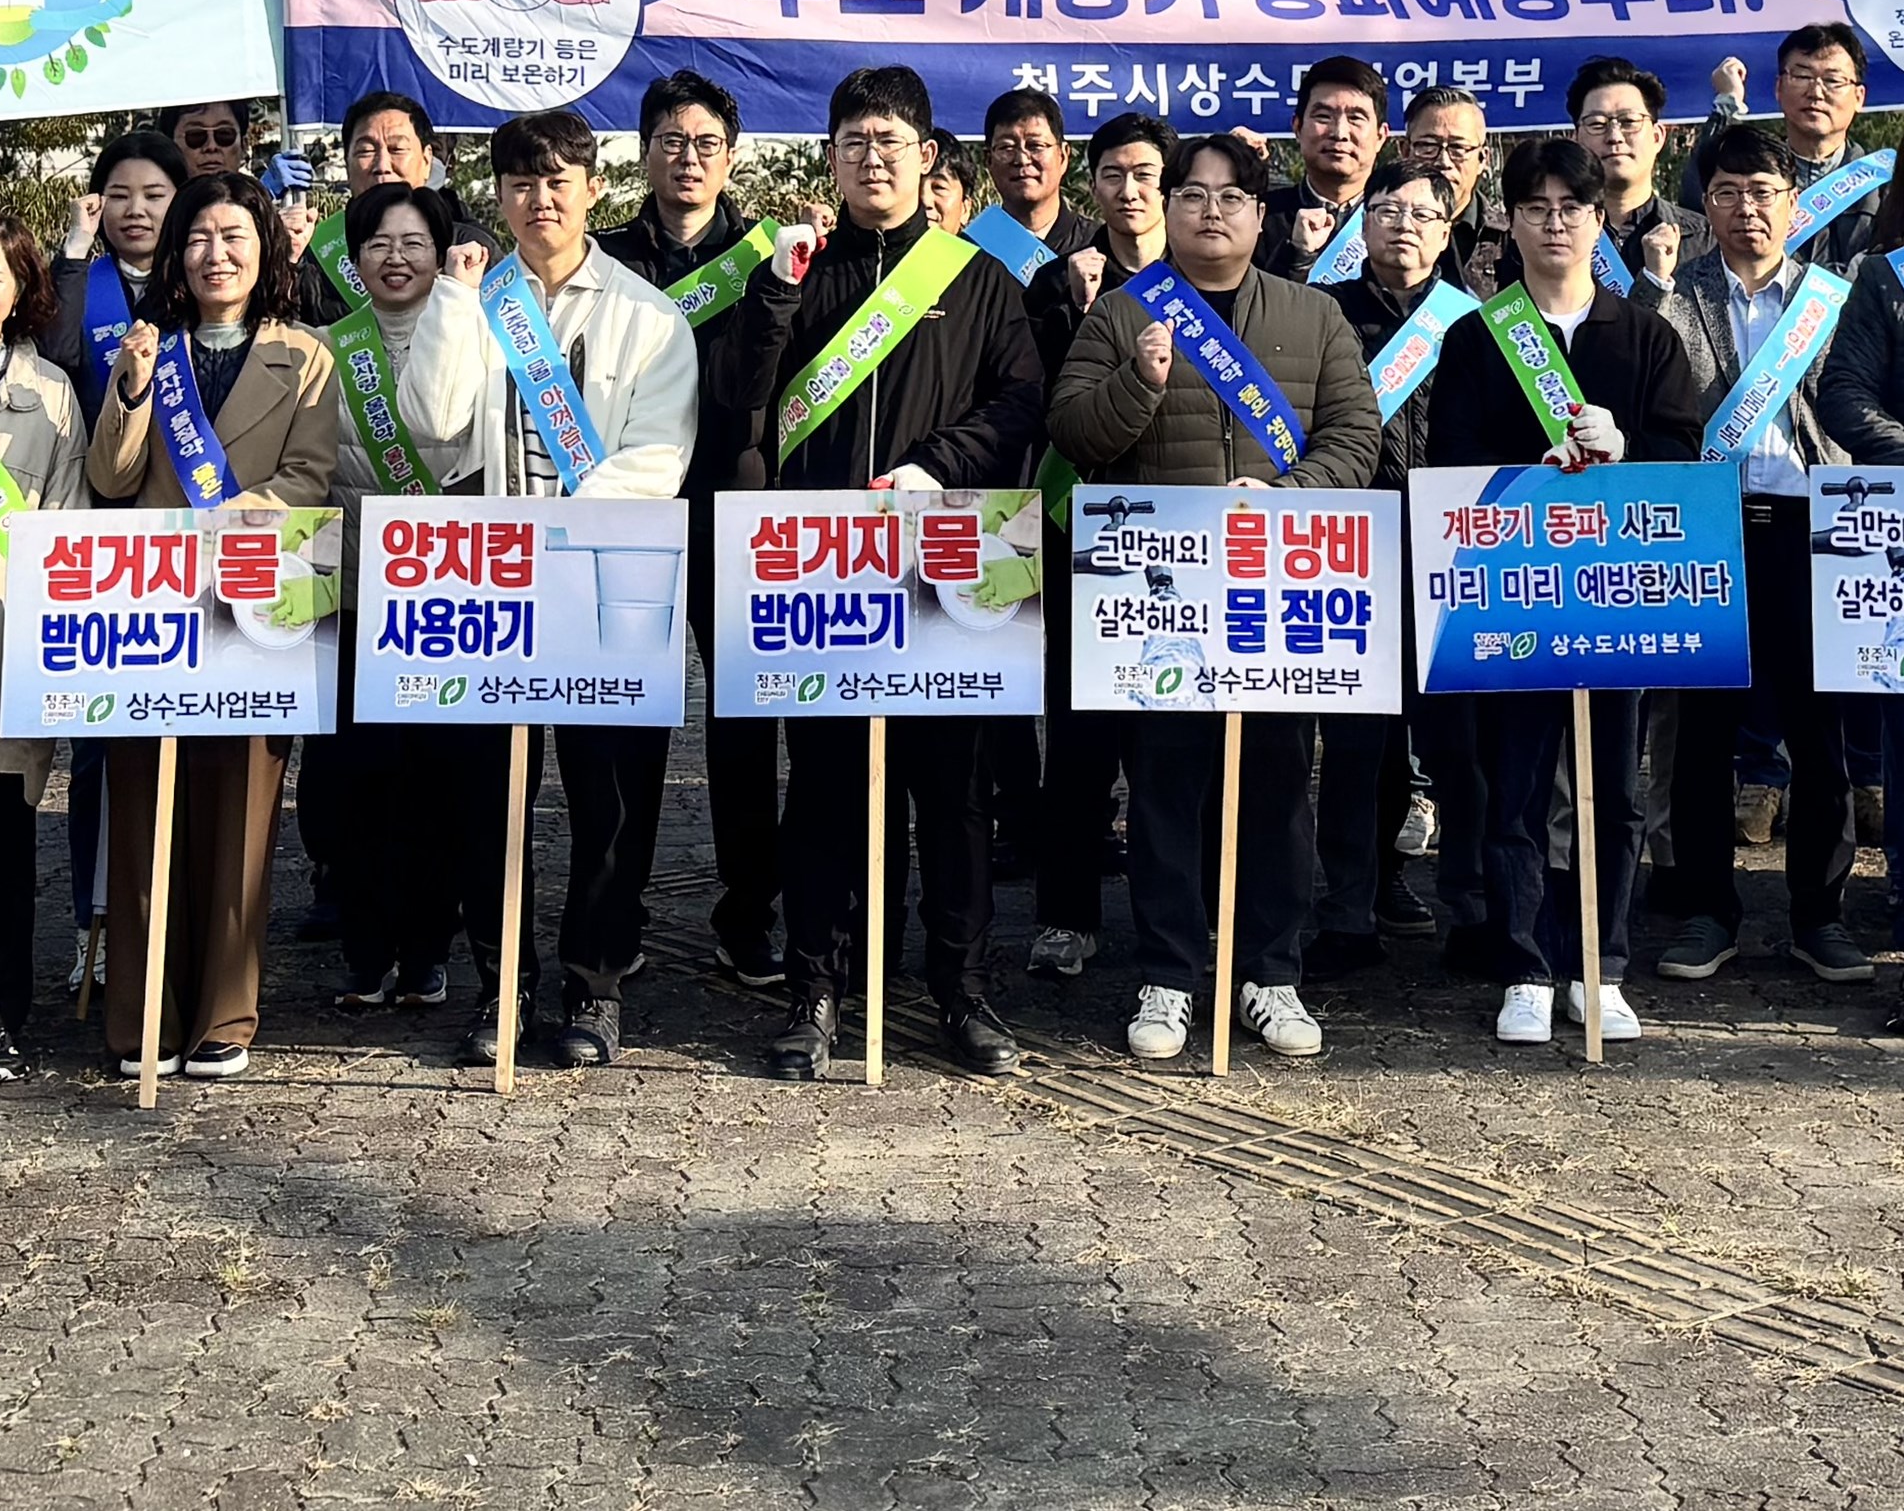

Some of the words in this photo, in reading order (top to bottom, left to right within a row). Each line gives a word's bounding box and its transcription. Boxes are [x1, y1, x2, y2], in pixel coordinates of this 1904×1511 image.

[437, 36, 544, 59] 수도계량기
[554, 39, 597, 60] 등은
[449, 63, 489, 83] 미리
[501, 63, 585, 86] 보온하기
[499, 297, 540, 356] 소중한
[526, 358, 552, 384] 물
[749, 515, 900, 581] 설거지
[920, 514, 981, 581] 물
[1091, 530, 1210, 567] 그만해요!
[1224, 509, 1268, 569] 물
[1282, 510, 1371, 579] 낭비
[1443, 505, 1533, 548] 계량기
[1543, 504, 1607, 545] 동파
[1622, 501, 1683, 542] 사고
[43, 535, 196, 599] 설거지
[218, 532, 279, 599] 물
[382, 518, 535, 589] 양치컵
[1429, 568, 1489, 610] 미리
[1502, 565, 1562, 607] 미리
[1576, 562, 1732, 608] 예방합시다
[41, 612, 197, 670] 받아쓰기
[378, 596, 536, 657] 사용하기
[751, 591, 906, 650] 받아쓰기
[1093, 595, 1208, 638] 실천해요!
[1225, 592, 1267, 653] 물
[1281, 587, 1373, 656] 절약
[1551, 632, 1703, 657] 상수도사업본부
[126, 691, 298, 721] 상수도사업본부
[478, 675, 645, 706] 상수도사업본부
[835, 671, 1004, 701] 상수도사업본부
[1194, 666, 1363, 693] 상수도사업본부
